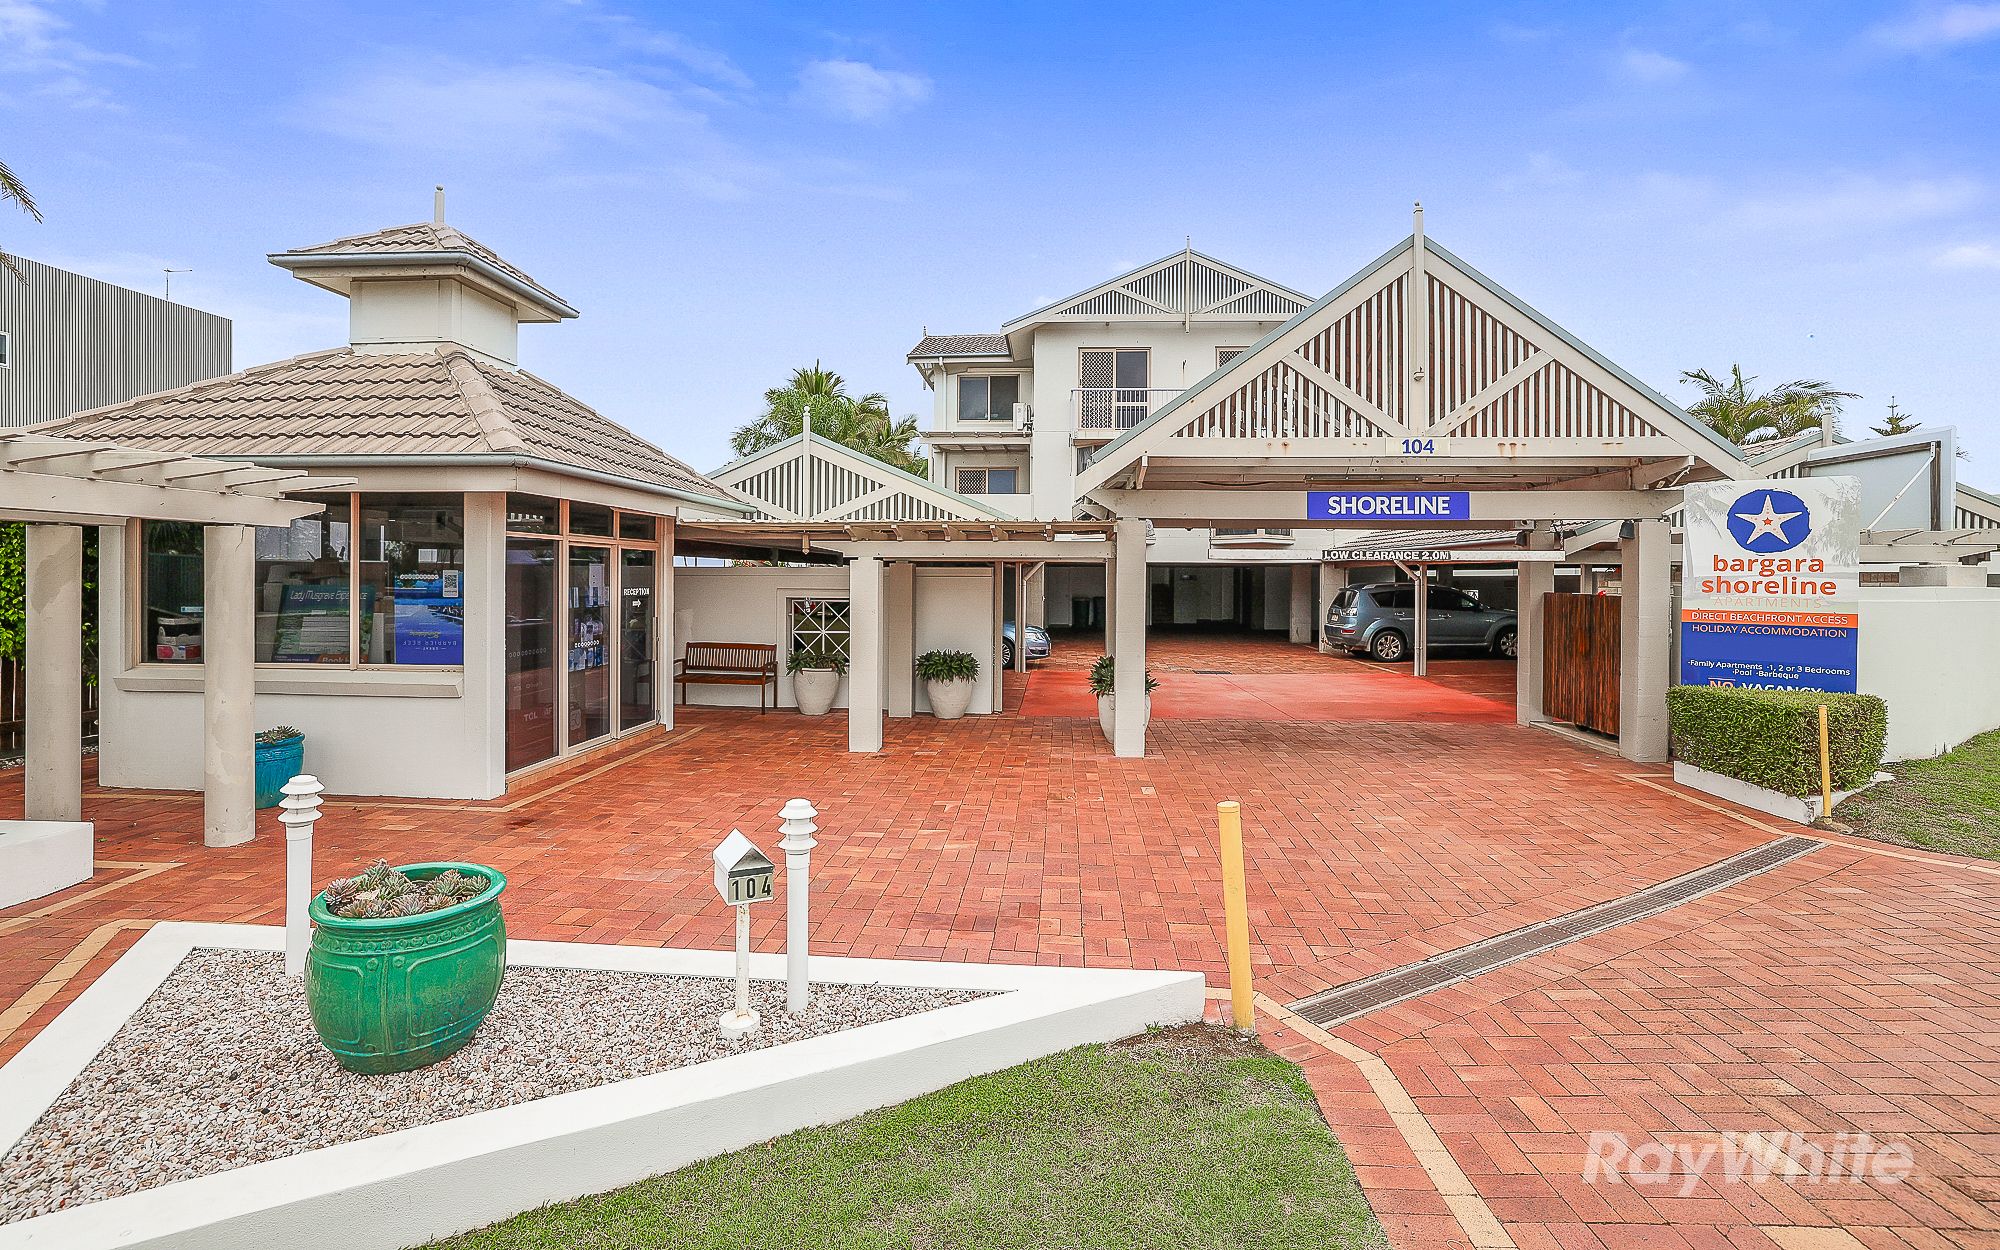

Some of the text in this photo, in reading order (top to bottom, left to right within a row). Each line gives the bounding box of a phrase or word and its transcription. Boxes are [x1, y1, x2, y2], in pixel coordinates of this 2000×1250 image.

[1402, 439, 1435, 454] 104
[1327, 496, 1450, 515] SHORELINE
[1324, 550, 1449, 560] LOW CLEARANCE 2.0M
[1713, 555, 1824, 577] bargara
[623, 587, 650, 596] RECEPTION
[1701, 576, 1837, 596] shoreline
[305, 590, 335, 601] Musgrave
[1713, 597, 1822, 609] APARTMENTS
[1691, 611, 1848, 625] DIRECT BEACHFRONT ACCESS
[1692, 624, 1847, 638] HOLIDAY ACCOMMODATION
[1715, 661, 1763, 671] Apartments
[1778, 664, 1784, 672] 2
[1797, 665, 1802, 673] 3
[1804, 666, 1851, 676] Bedrooms
[731, 876, 772, 901] 104
